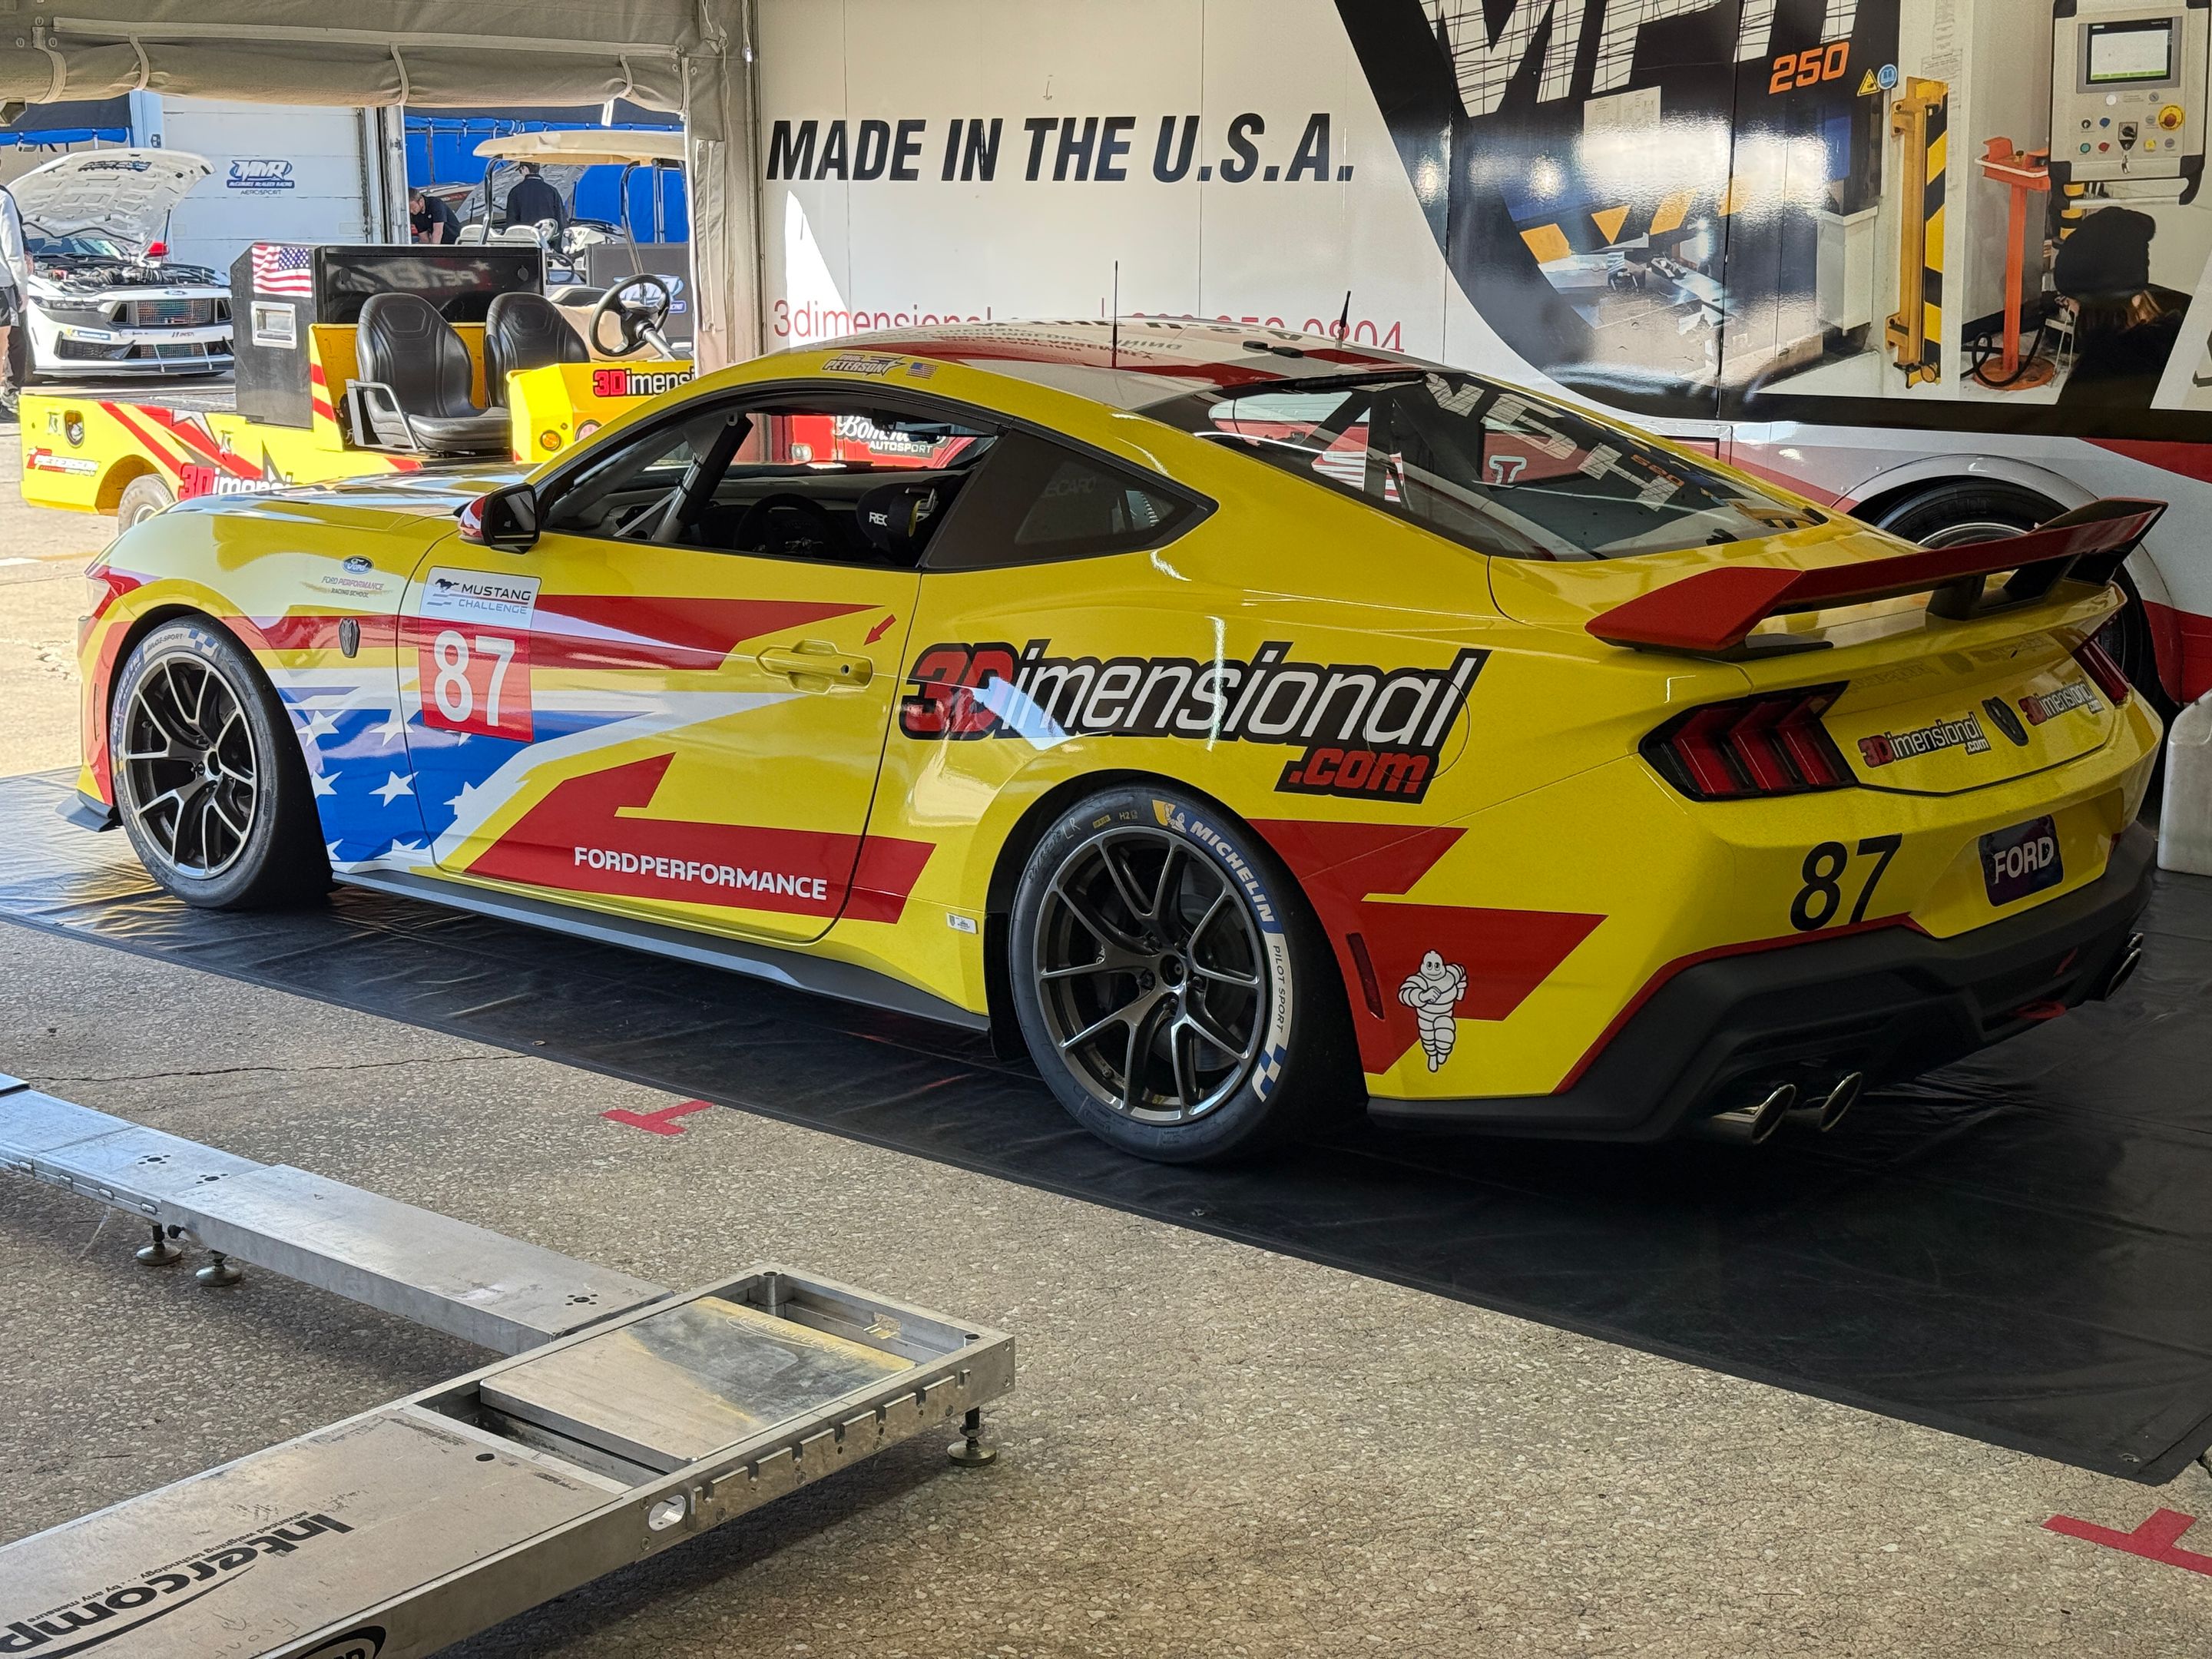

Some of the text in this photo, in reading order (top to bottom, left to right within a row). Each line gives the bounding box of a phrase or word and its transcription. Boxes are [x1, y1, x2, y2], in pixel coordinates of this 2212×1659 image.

[1769, 41, 1849, 94] 250
[767, 113, 1355, 182] MADE IN THE U.S.A.
[824, 360, 884, 374] PETERSON
[593, 369, 694, 396] 3Dimens
[869, 440, 932, 454] AUTOSPORT
[869, 512, 888, 526] REC
[322, 576, 384, 591] FORD PERFORMANCE
[330, 588, 349, 596] RACING
[462, 583, 531, 601] MUSTANG
[458, 599, 528, 615] CHALLENGE
[434, 630, 516, 727] 87
[902, 647, 1484, 747] 3Dimensional
[2018, 676, 2096, 726] 3Dimensional
[1858, 712, 1983, 767] 3Dimensional
[1966, 737, 1990, 756] .com
[1288, 750, 1432, 796] .com
[1993, 836, 2055, 885] FORD
[1790, 833, 1902, 931] 87
[1190, 820, 1287, 1033] MICHELIN PILOT SPORT
[257, 1512, 309, 1535] advanced
[204, 1531, 257, 1555] weighing
[141, 1551, 205, 1579] technology
[0, 1513, 355, 1654] Intercomp
[81, 1588, 104, 1604] any
[26, 1598, 79, 1624] measure
